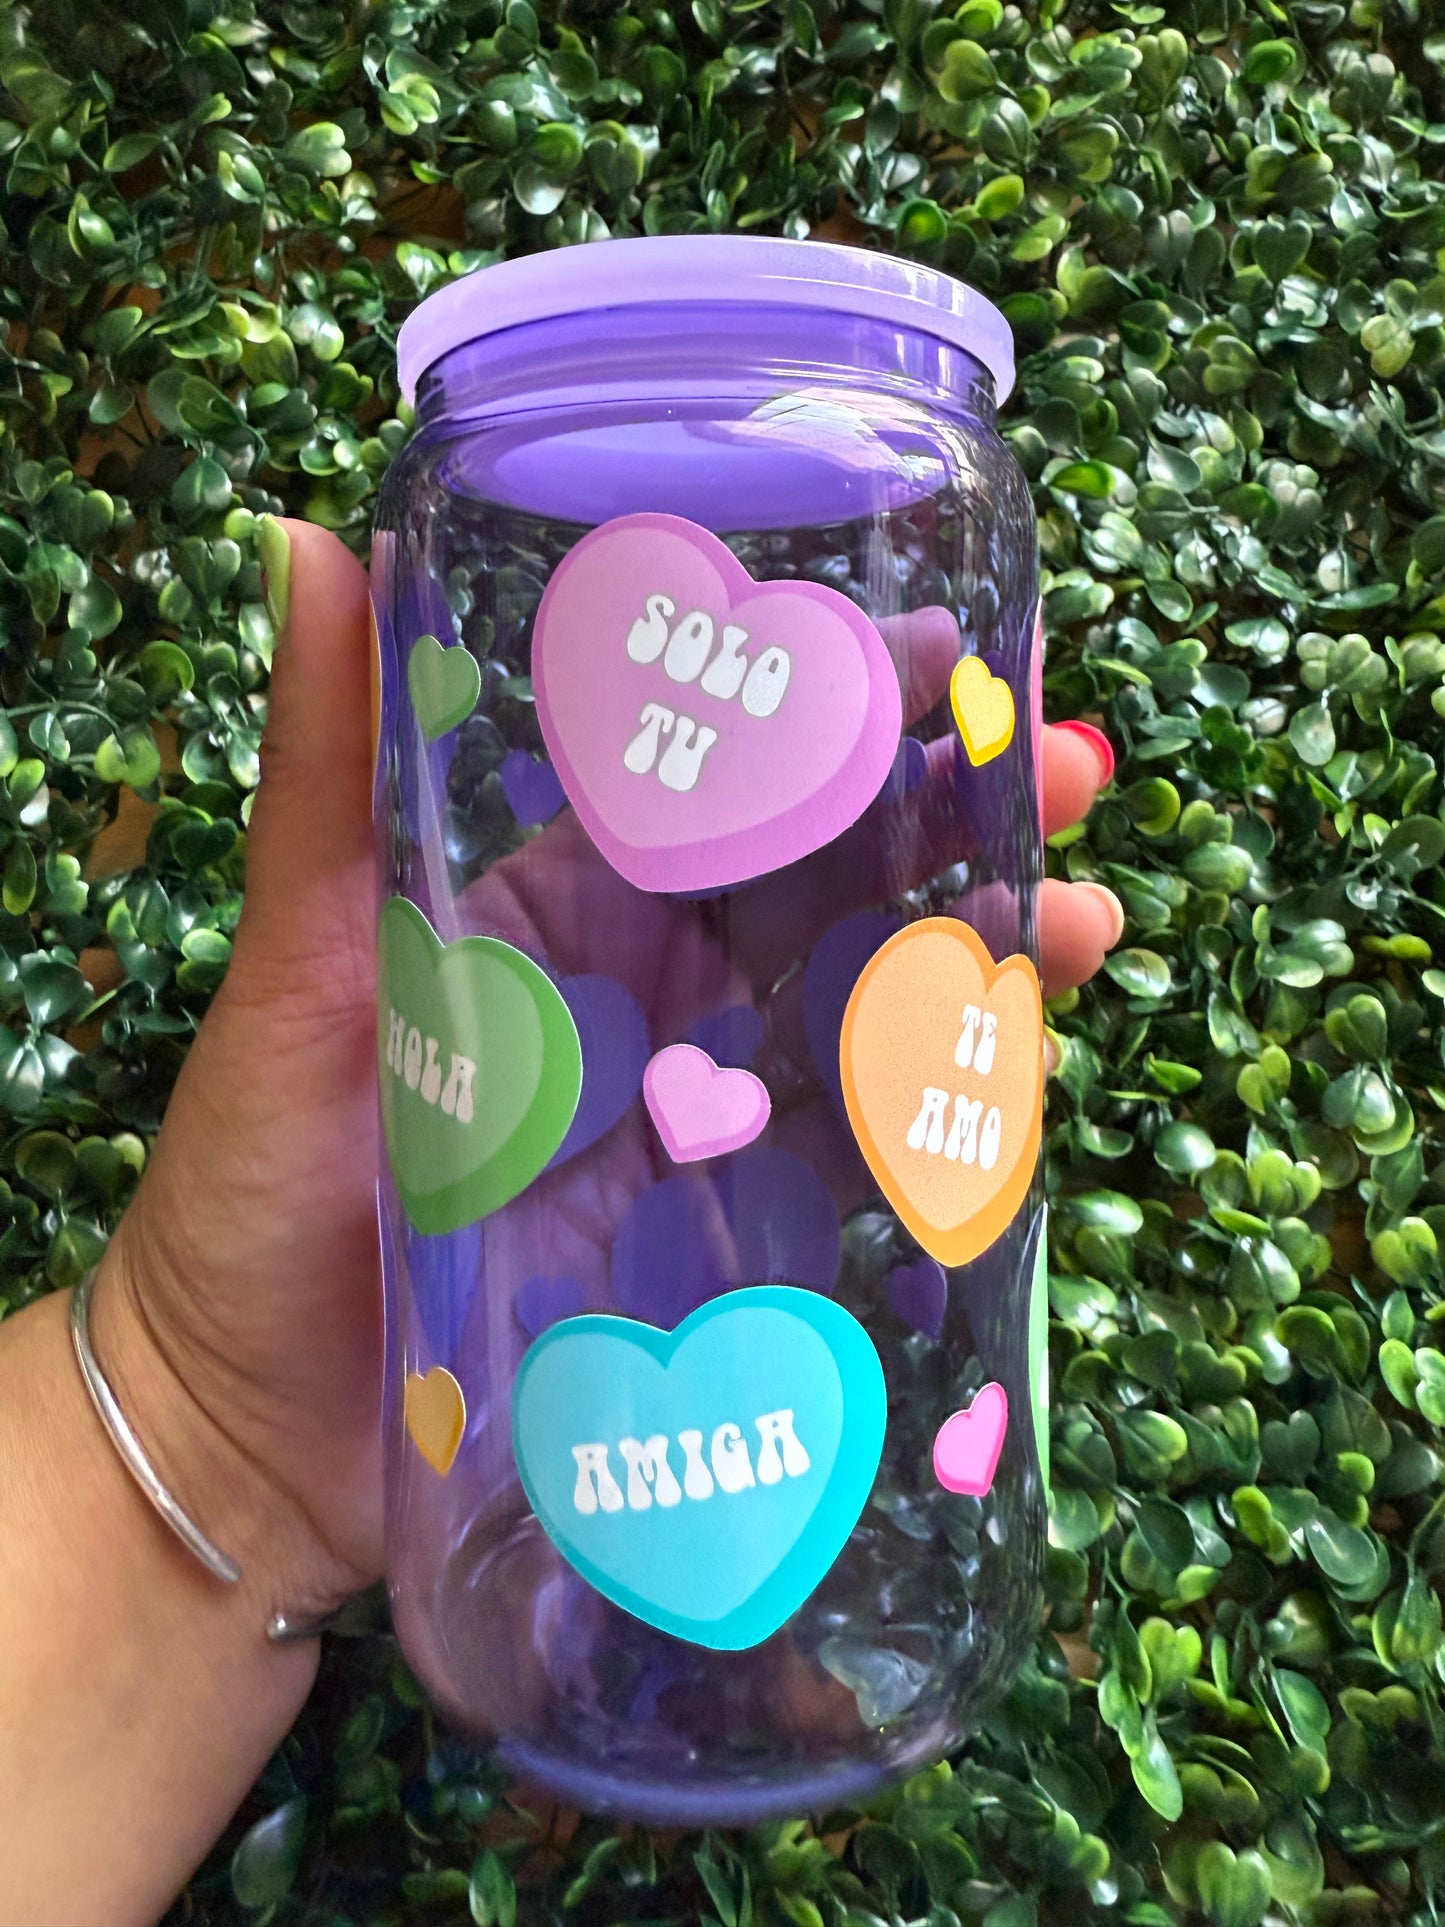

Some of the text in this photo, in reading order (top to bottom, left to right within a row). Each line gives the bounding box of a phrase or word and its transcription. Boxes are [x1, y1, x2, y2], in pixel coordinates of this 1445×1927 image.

[626, 593, 791, 718] SOLO
[623, 702, 718, 792] TU
[387, 1007, 477, 1124] HOLA
[954, 1003, 998, 1076] TE
[906, 1086, 1002, 1171] AMO
[571, 1408, 811, 1516] AMIGA
